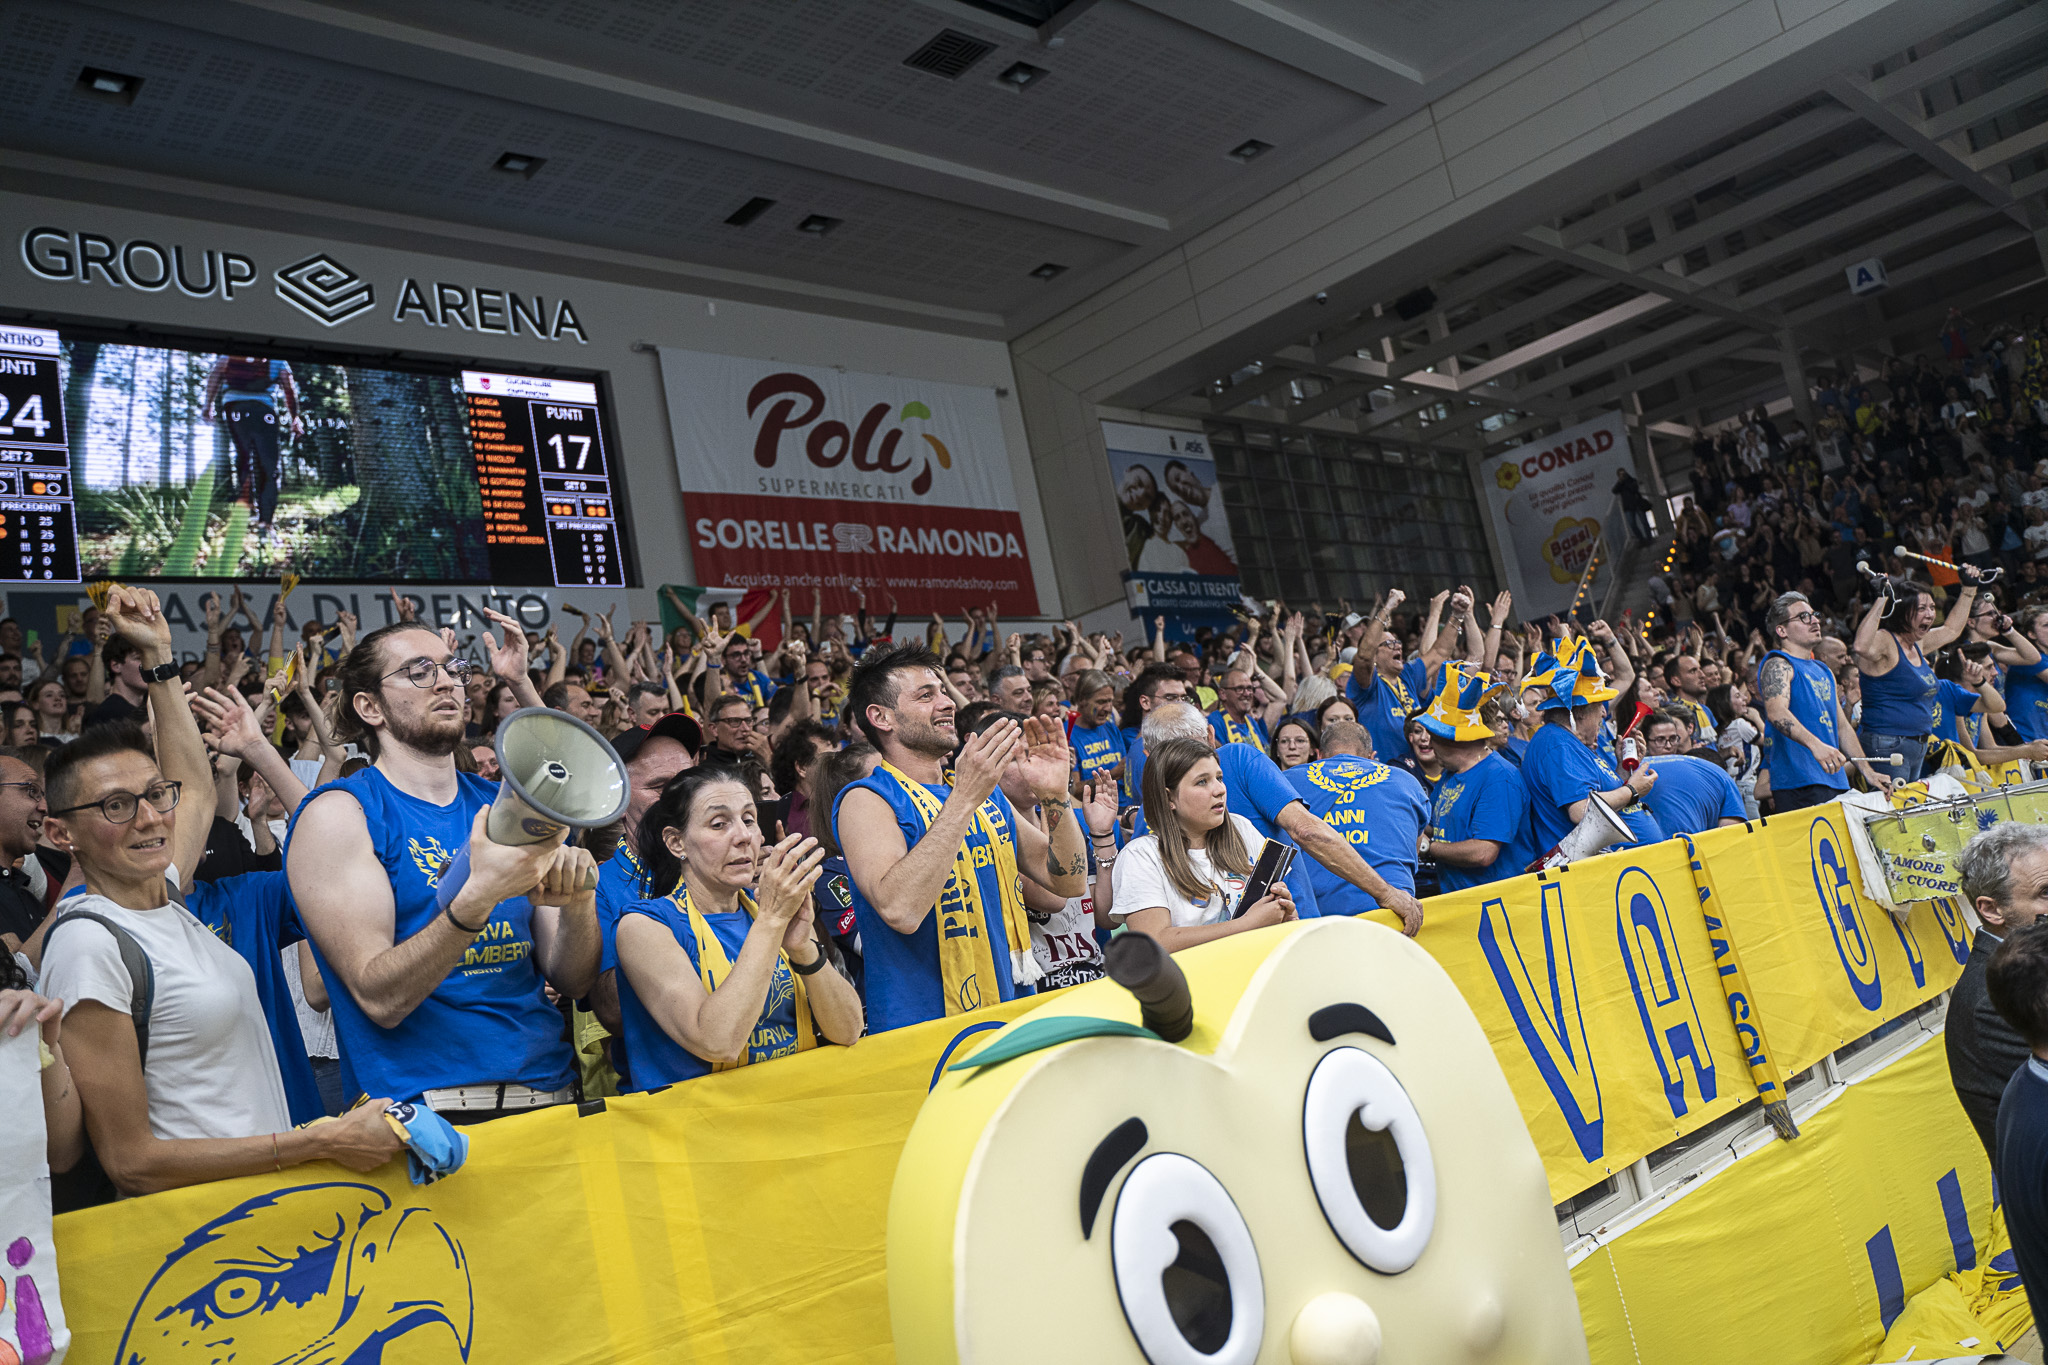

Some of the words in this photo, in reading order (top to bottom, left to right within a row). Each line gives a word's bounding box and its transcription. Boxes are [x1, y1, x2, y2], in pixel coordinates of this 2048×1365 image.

[22, 226, 258, 300] GROUP
[394, 278, 588, 344] ARENA
[1857, 266, 1874, 287] A
[546, 406, 583, 421] PUNTI
[547, 433, 592, 470] 17
[1521, 429, 1614, 478] CONAD
[758, 476, 905, 501] SUPERMERCATI
[0, 501, 62, 512] PRECEDENTI
[39, 516, 53, 527] 25
[40, 529, 55, 540] 25
[695, 517, 832, 551] SORELLE
[877, 526, 1024, 559] RAMONDA
[723, 573, 781, 589] Acquista
[784, 573, 822, 588] anche
[824, 574, 862, 588] online
[886, 575, 1018, 592] www.ramondashop.com
[1149, 580, 1186, 596] CASSA
[1189, 582, 1201, 597] DI
[312, 593, 361, 630] DI
[1335, 791, 1355, 804] 20
[1323, 809, 1365, 826] ANNI
[1893, 856, 1946, 875] AMORE
[1907, 874, 1959, 893] CUORE
[474, 921, 515, 942] RVA
[748, 1024, 793, 1048] URVA
